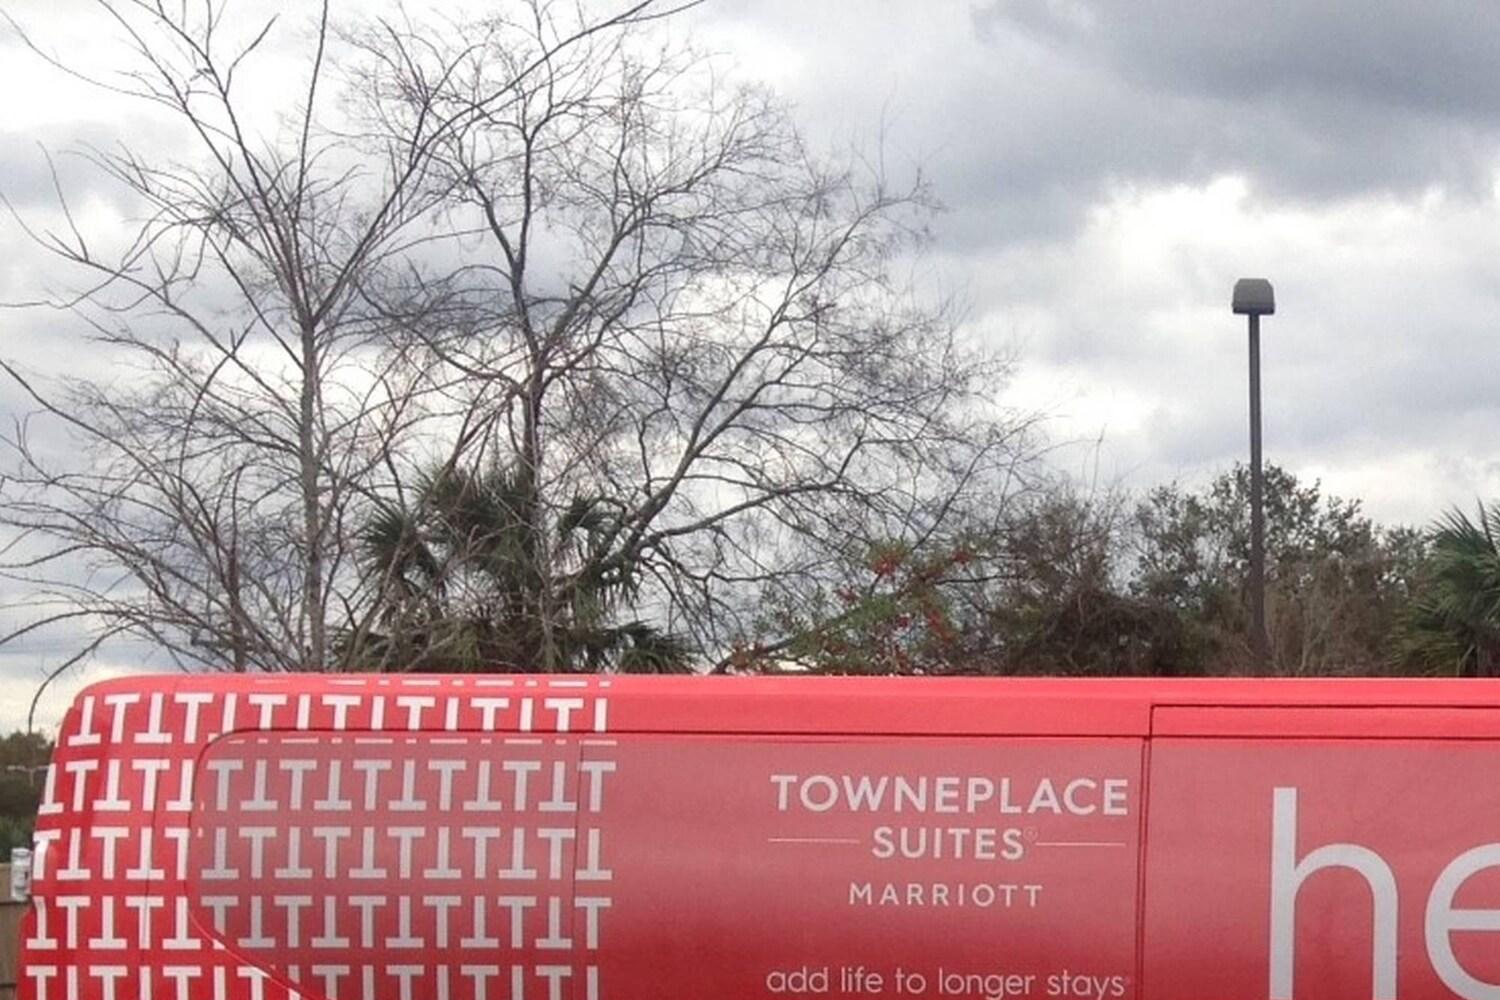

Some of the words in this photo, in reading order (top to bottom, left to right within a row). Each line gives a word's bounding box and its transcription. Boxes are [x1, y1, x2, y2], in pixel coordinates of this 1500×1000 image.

[770, 774, 1129, 815] TOWNEPLACE
[872, 826, 1024, 860] SUITES
[848, 882, 1043, 908] MARRIOTT
[766, 966, 828, 994] add
[840, 966, 884, 994] life
[894, 970, 927, 995] to
